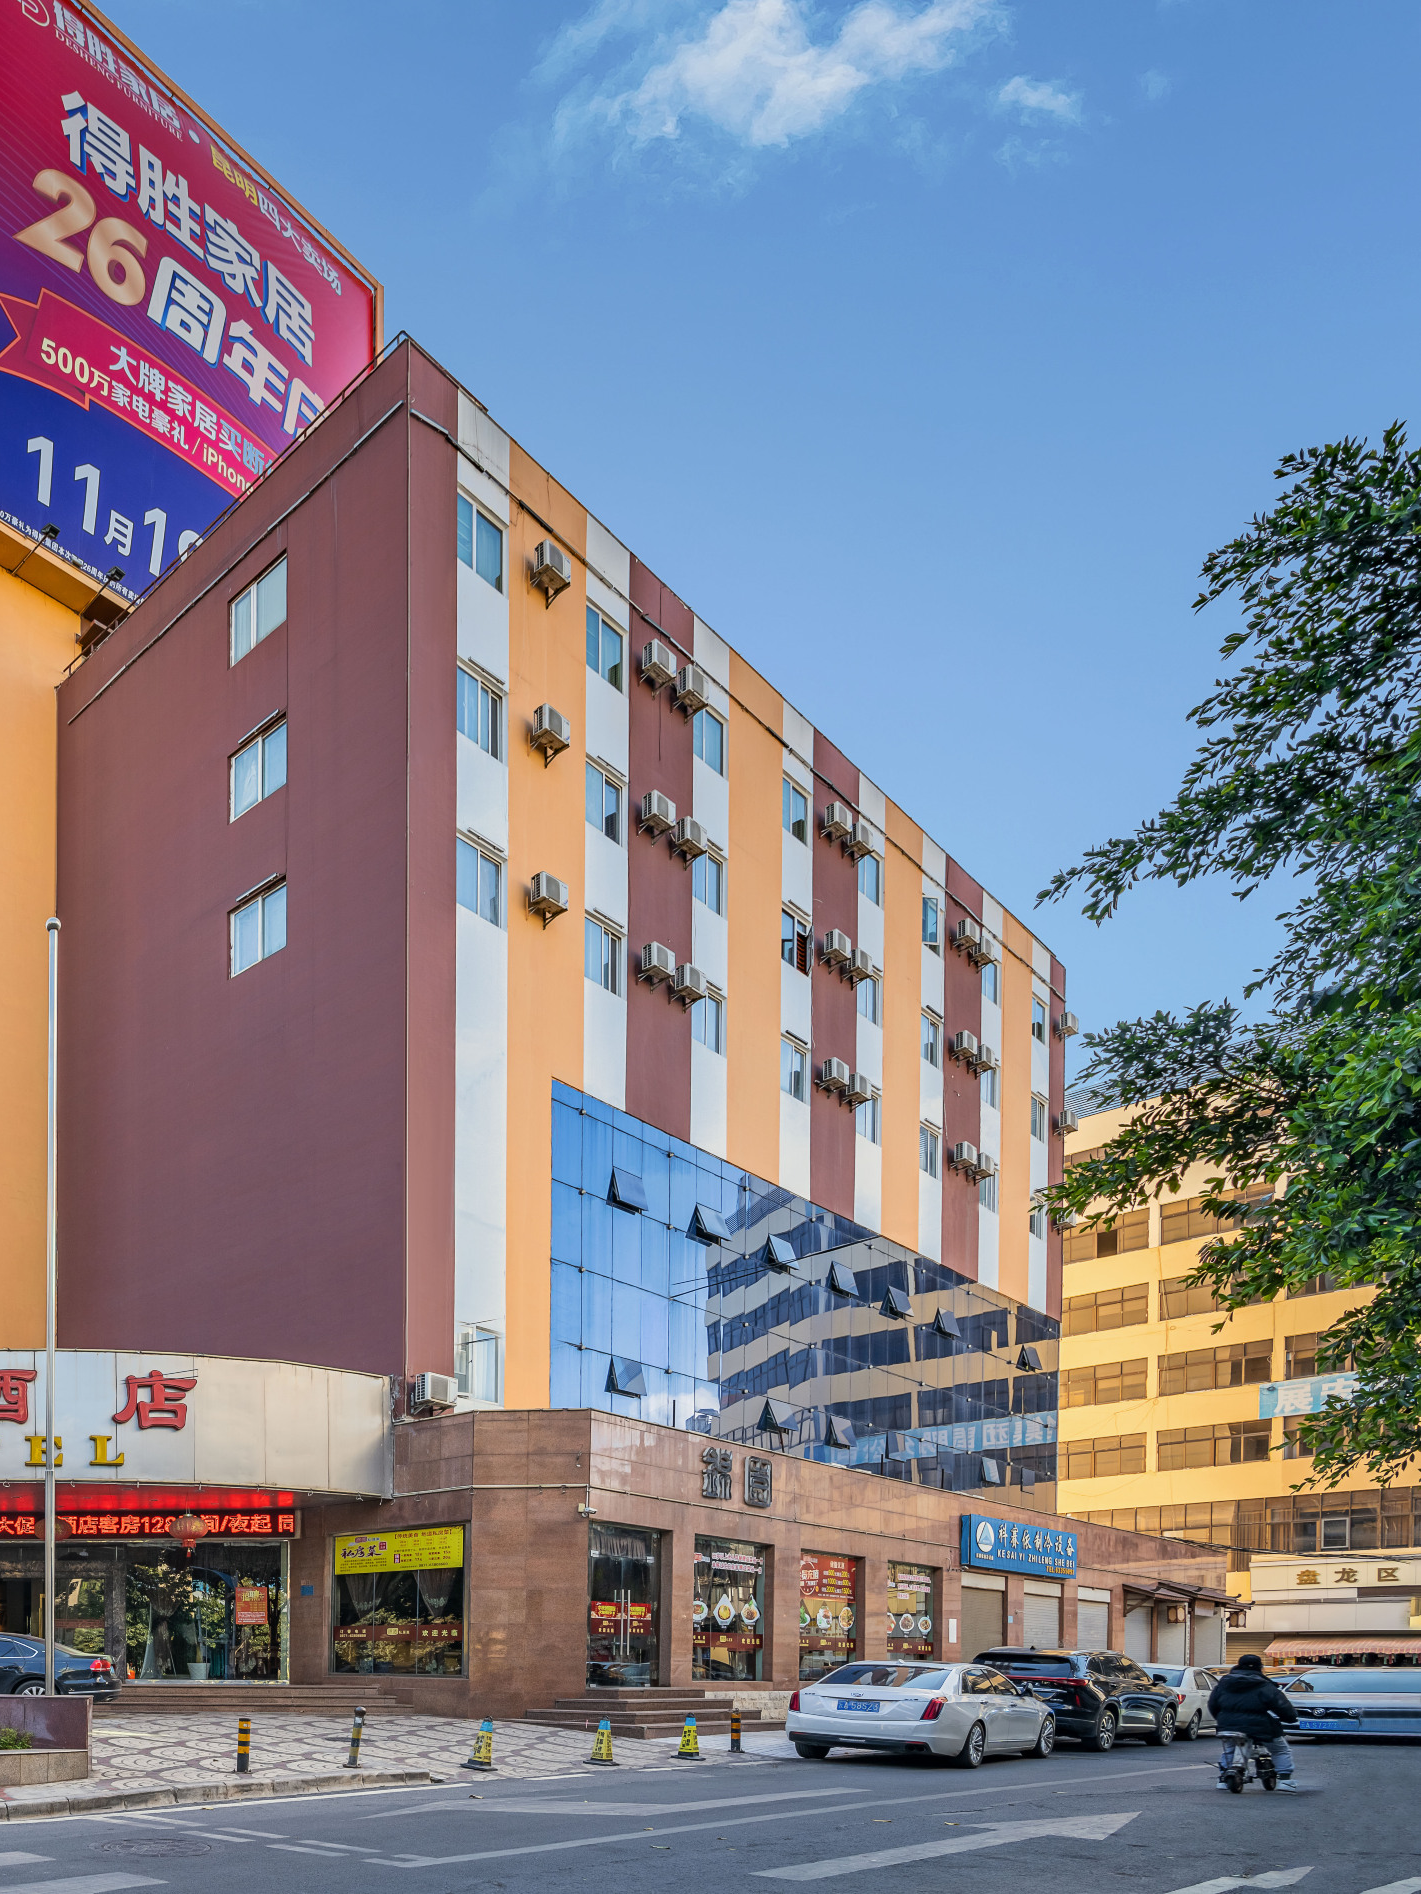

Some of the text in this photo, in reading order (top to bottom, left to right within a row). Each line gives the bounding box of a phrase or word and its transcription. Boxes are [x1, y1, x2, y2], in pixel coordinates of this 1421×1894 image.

[53, 0, 181, 130] 得胜家居
[55, 28, 184, 142] DESHENG FURNITURE
[60, 90, 316, 367] 得胜家居
[210, 143, 342, 296] 昆明四大卖场
[109, 345, 275, 480] 大牌家居买断
[1019, 1552, 1026, 1561] YI
[1296, 1567, 1400, 1586] 盘龙区
